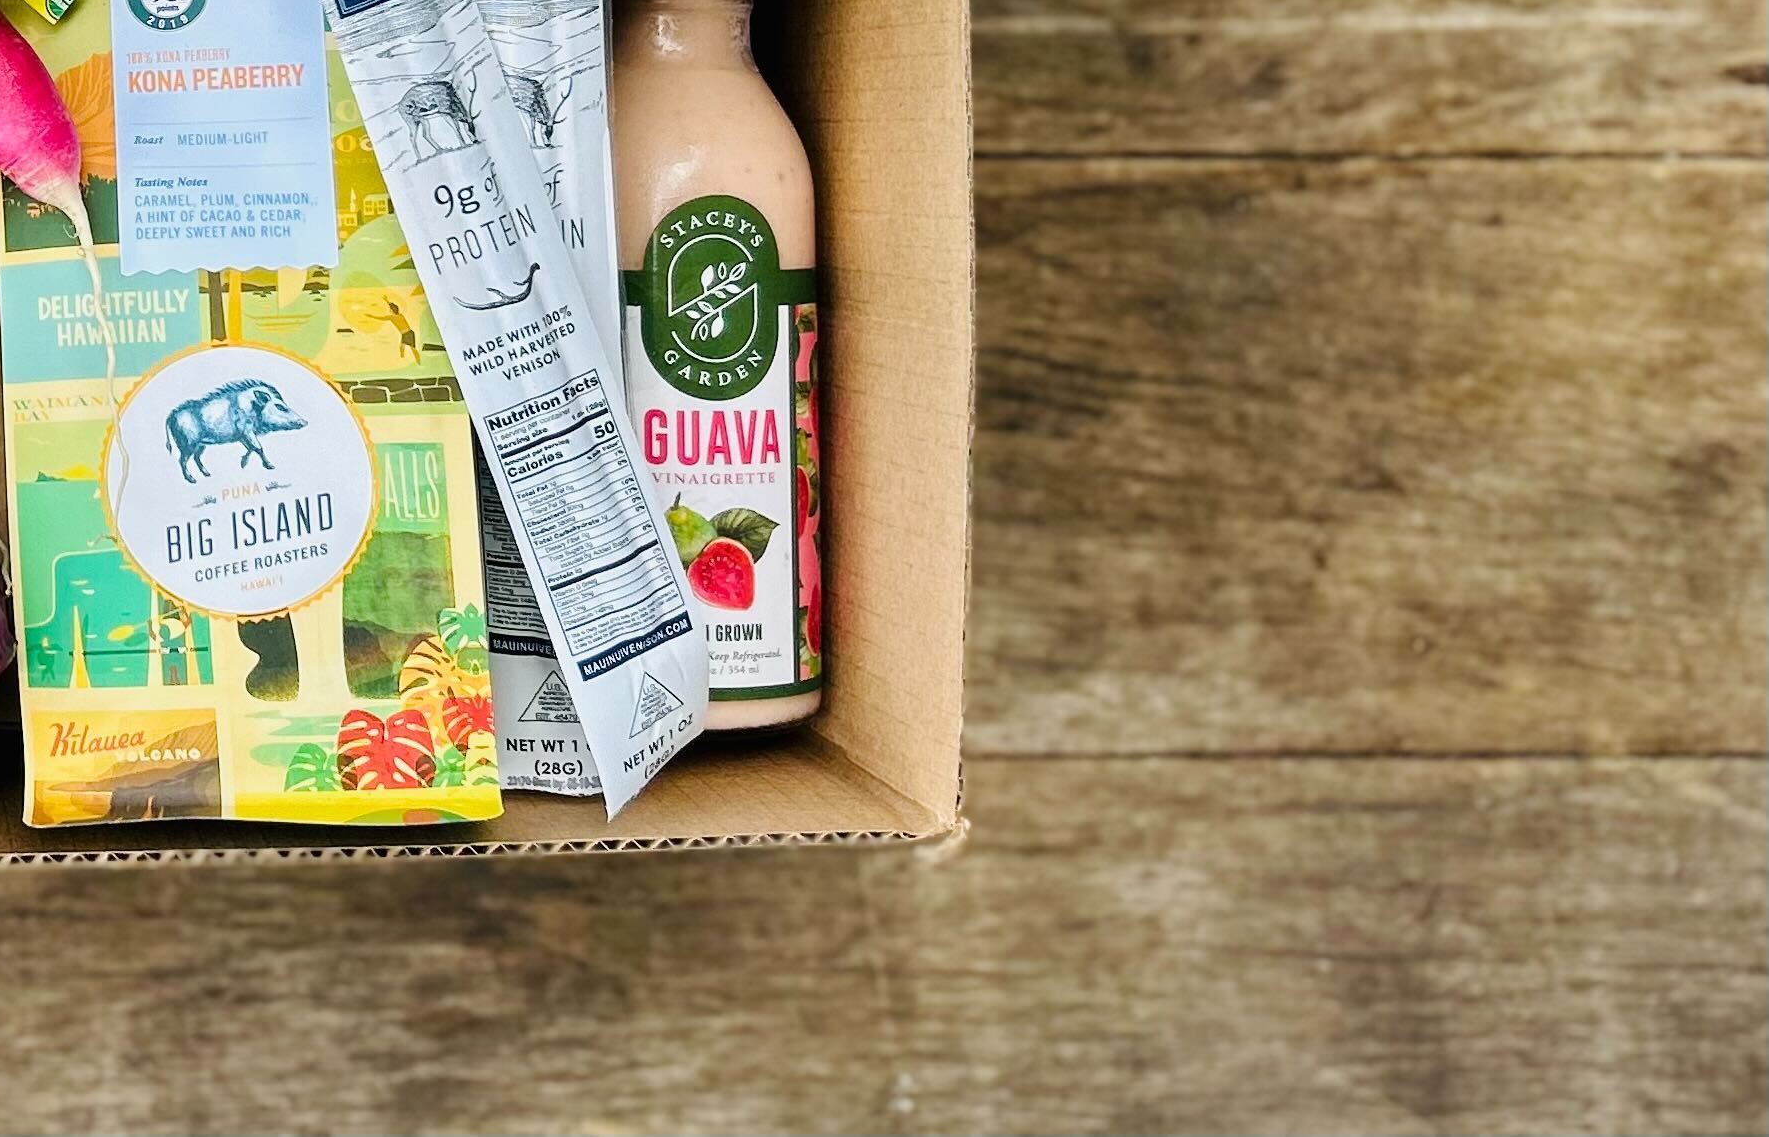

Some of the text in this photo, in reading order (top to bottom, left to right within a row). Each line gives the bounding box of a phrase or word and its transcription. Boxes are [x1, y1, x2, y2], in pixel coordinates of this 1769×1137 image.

[146, 14, 189, 30] 2019
[127, 64, 305, 93] KONA PEABERRY
[133, 131, 269, 147] Roast MEDIUM-LIGHT
[434, 184, 480, 218] 9g
[147, 210, 242, 223] HINT CACAO
[135, 225, 291, 240] DEEPLY SWEET AND RICH
[429, 204, 537, 275] PROTEIN
[38, 289, 191, 320] DELIGHTFULLY
[56, 319, 167, 348] HAWAIIAN
[463, 305, 572, 361] MADE WITH 100%
[469, 322, 576, 376] WILD HARVESTED
[502, 349, 562, 381] VENISON
[663, 349, 764, 388] GARDEN
[488, 396, 561, 431] Nutrition
[644, 409, 782, 465] GUAVA
[507, 450, 564, 479] Calories
[652, 471, 776, 485] VINAIGRETTE
[222, 482, 261, 501] PUNA
[166, 492, 335, 564] BIG ISLAND
[195, 543, 329, 583] COFFEE ROASTERS
[716, 623, 763, 642] GROWN
[583, 618, 690, 677] MAUINUIVENISON.COM
[113, 747, 201, 762] VOLCANO
[506, 739, 565, 752] NET WT
[535, 760, 583, 776] (28G)
